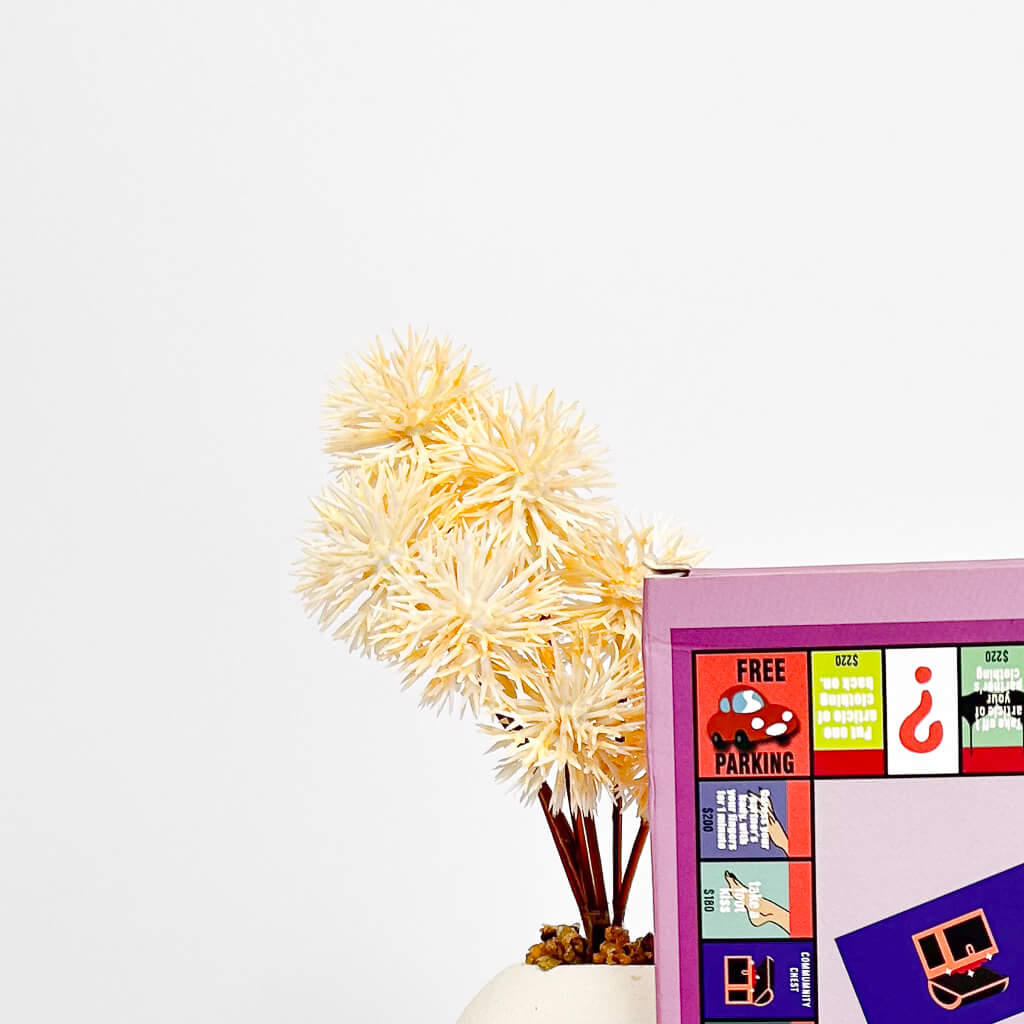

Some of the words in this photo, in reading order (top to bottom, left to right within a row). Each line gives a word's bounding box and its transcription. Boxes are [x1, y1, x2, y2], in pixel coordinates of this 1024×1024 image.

[985, 650, 1008, 663] $220
[737, 658, 786, 683] FREE
[715, 752, 795, 775] PARKING
[702, 807, 714, 832] $200
